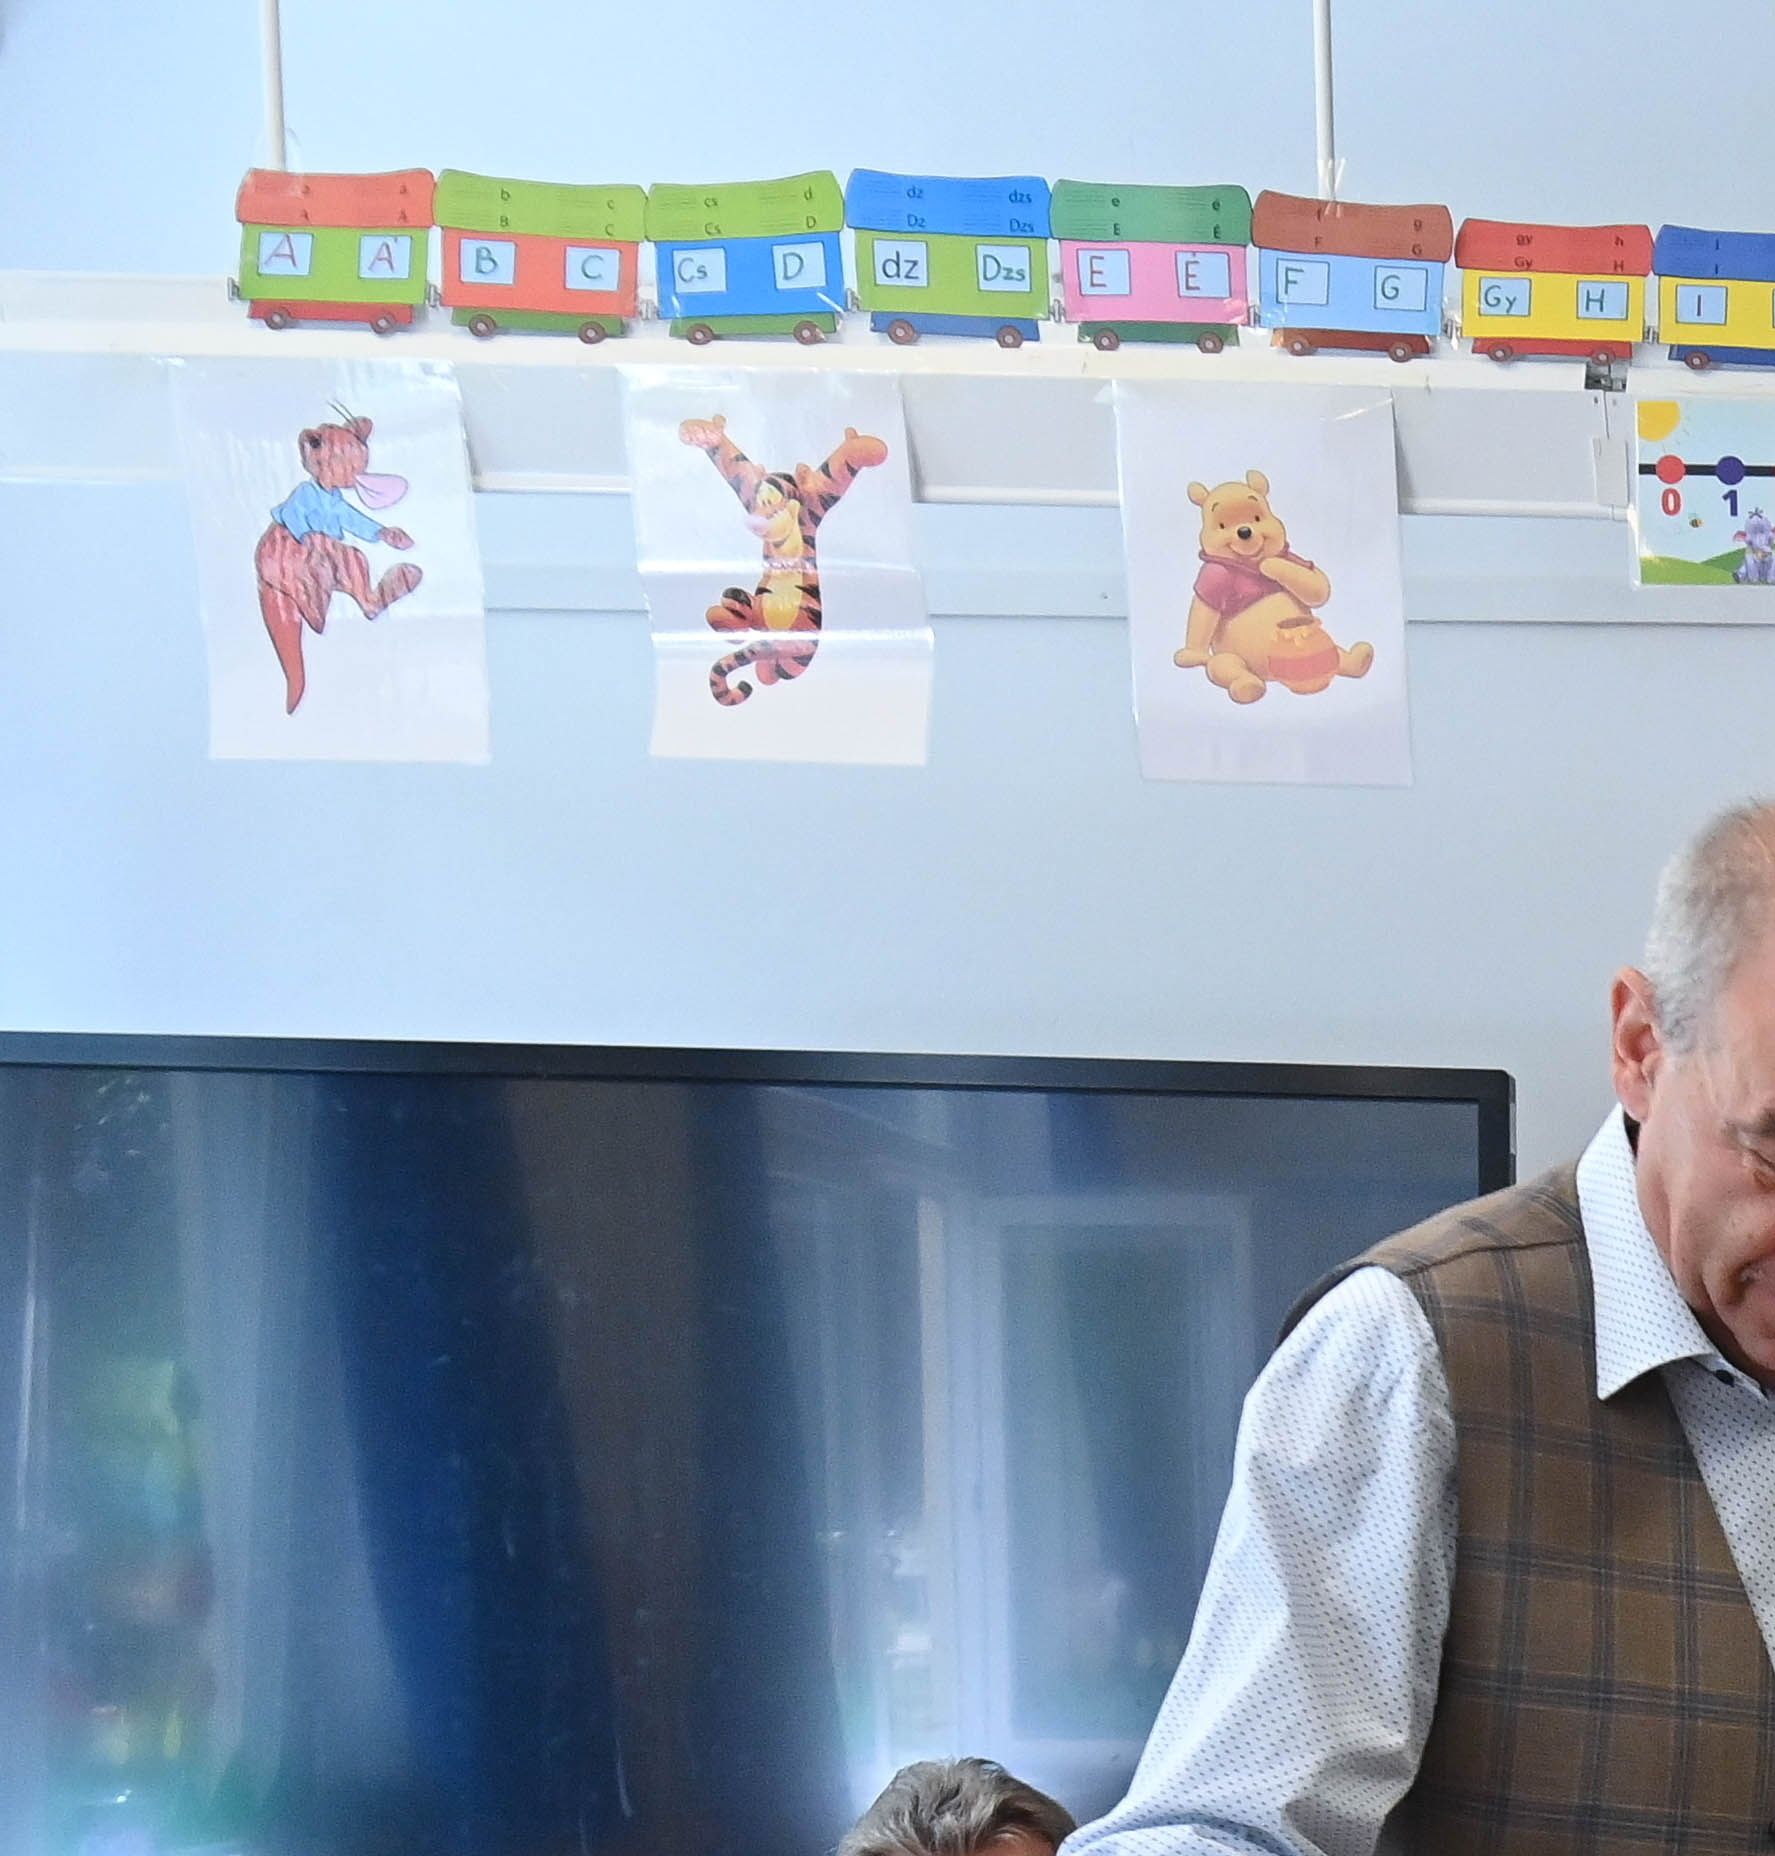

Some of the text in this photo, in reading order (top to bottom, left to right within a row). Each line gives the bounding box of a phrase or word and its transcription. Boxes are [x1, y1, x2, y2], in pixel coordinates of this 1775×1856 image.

[264, 236, 299, 269] A
[475, 247, 498, 274] B
[581, 255, 603, 280] C
[678, 258, 707, 283] Cs
[783, 252, 804, 280] D
[882, 251, 918, 279] dz
[983, 254, 1025, 281] Dzs
[1090, 256, 1106, 287] E
[1285, 267, 1304, 294] F
[1381, 275, 1399, 300] G
[1485, 284, 1518, 315] Gy
[1586, 289, 1604, 312] H
[1662, 488, 1681, 515] 0
[1723, 490, 1738, 516] 1
